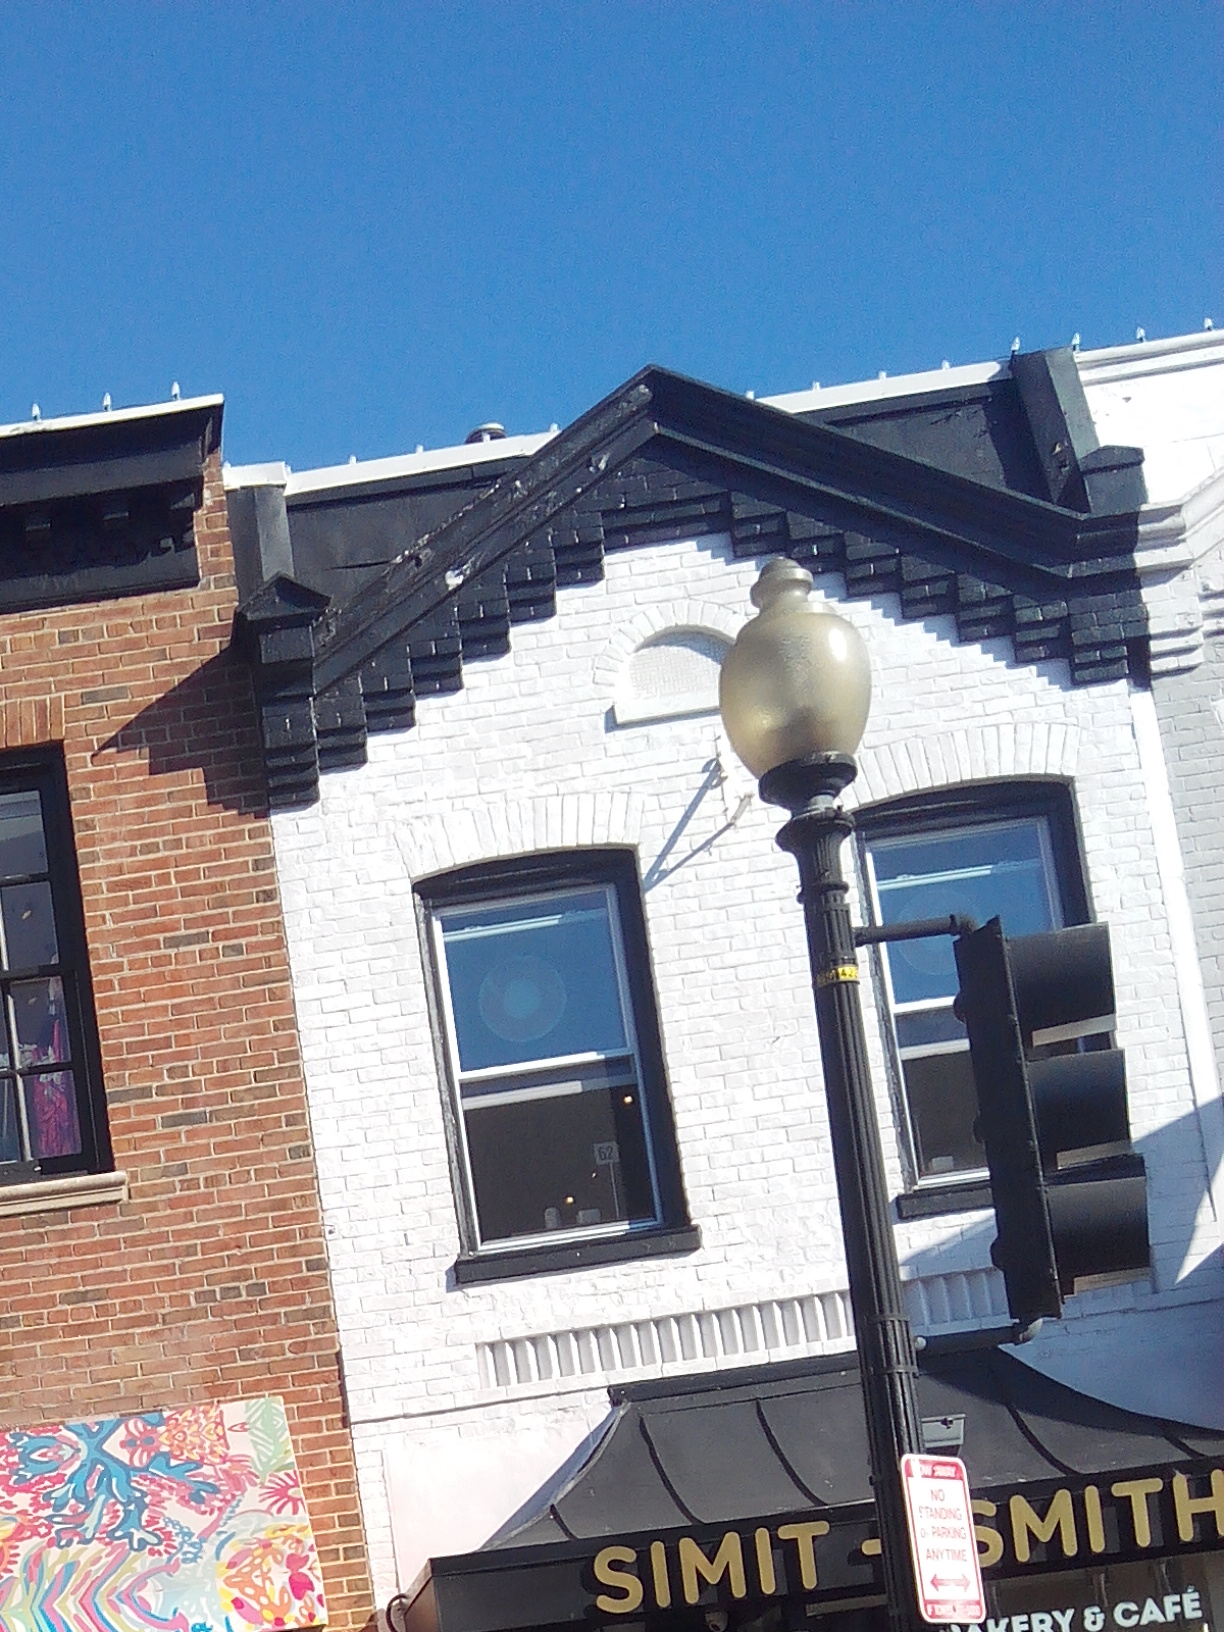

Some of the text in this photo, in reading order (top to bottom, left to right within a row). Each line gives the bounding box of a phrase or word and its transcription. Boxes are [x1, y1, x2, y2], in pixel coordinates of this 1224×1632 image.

[930, 1488, 945, 1502] NO
[918, 1505, 963, 1521] STANDING
[932, 1525, 967, 1540] PARKING
[926, 1548, 968, 1563] ANYTIME
[594, 1520, 831, 1614] SIMIT
[1083, 1605, 1106, 1632] &
[1112, 1585, 1203, 1628] CAFÉ
